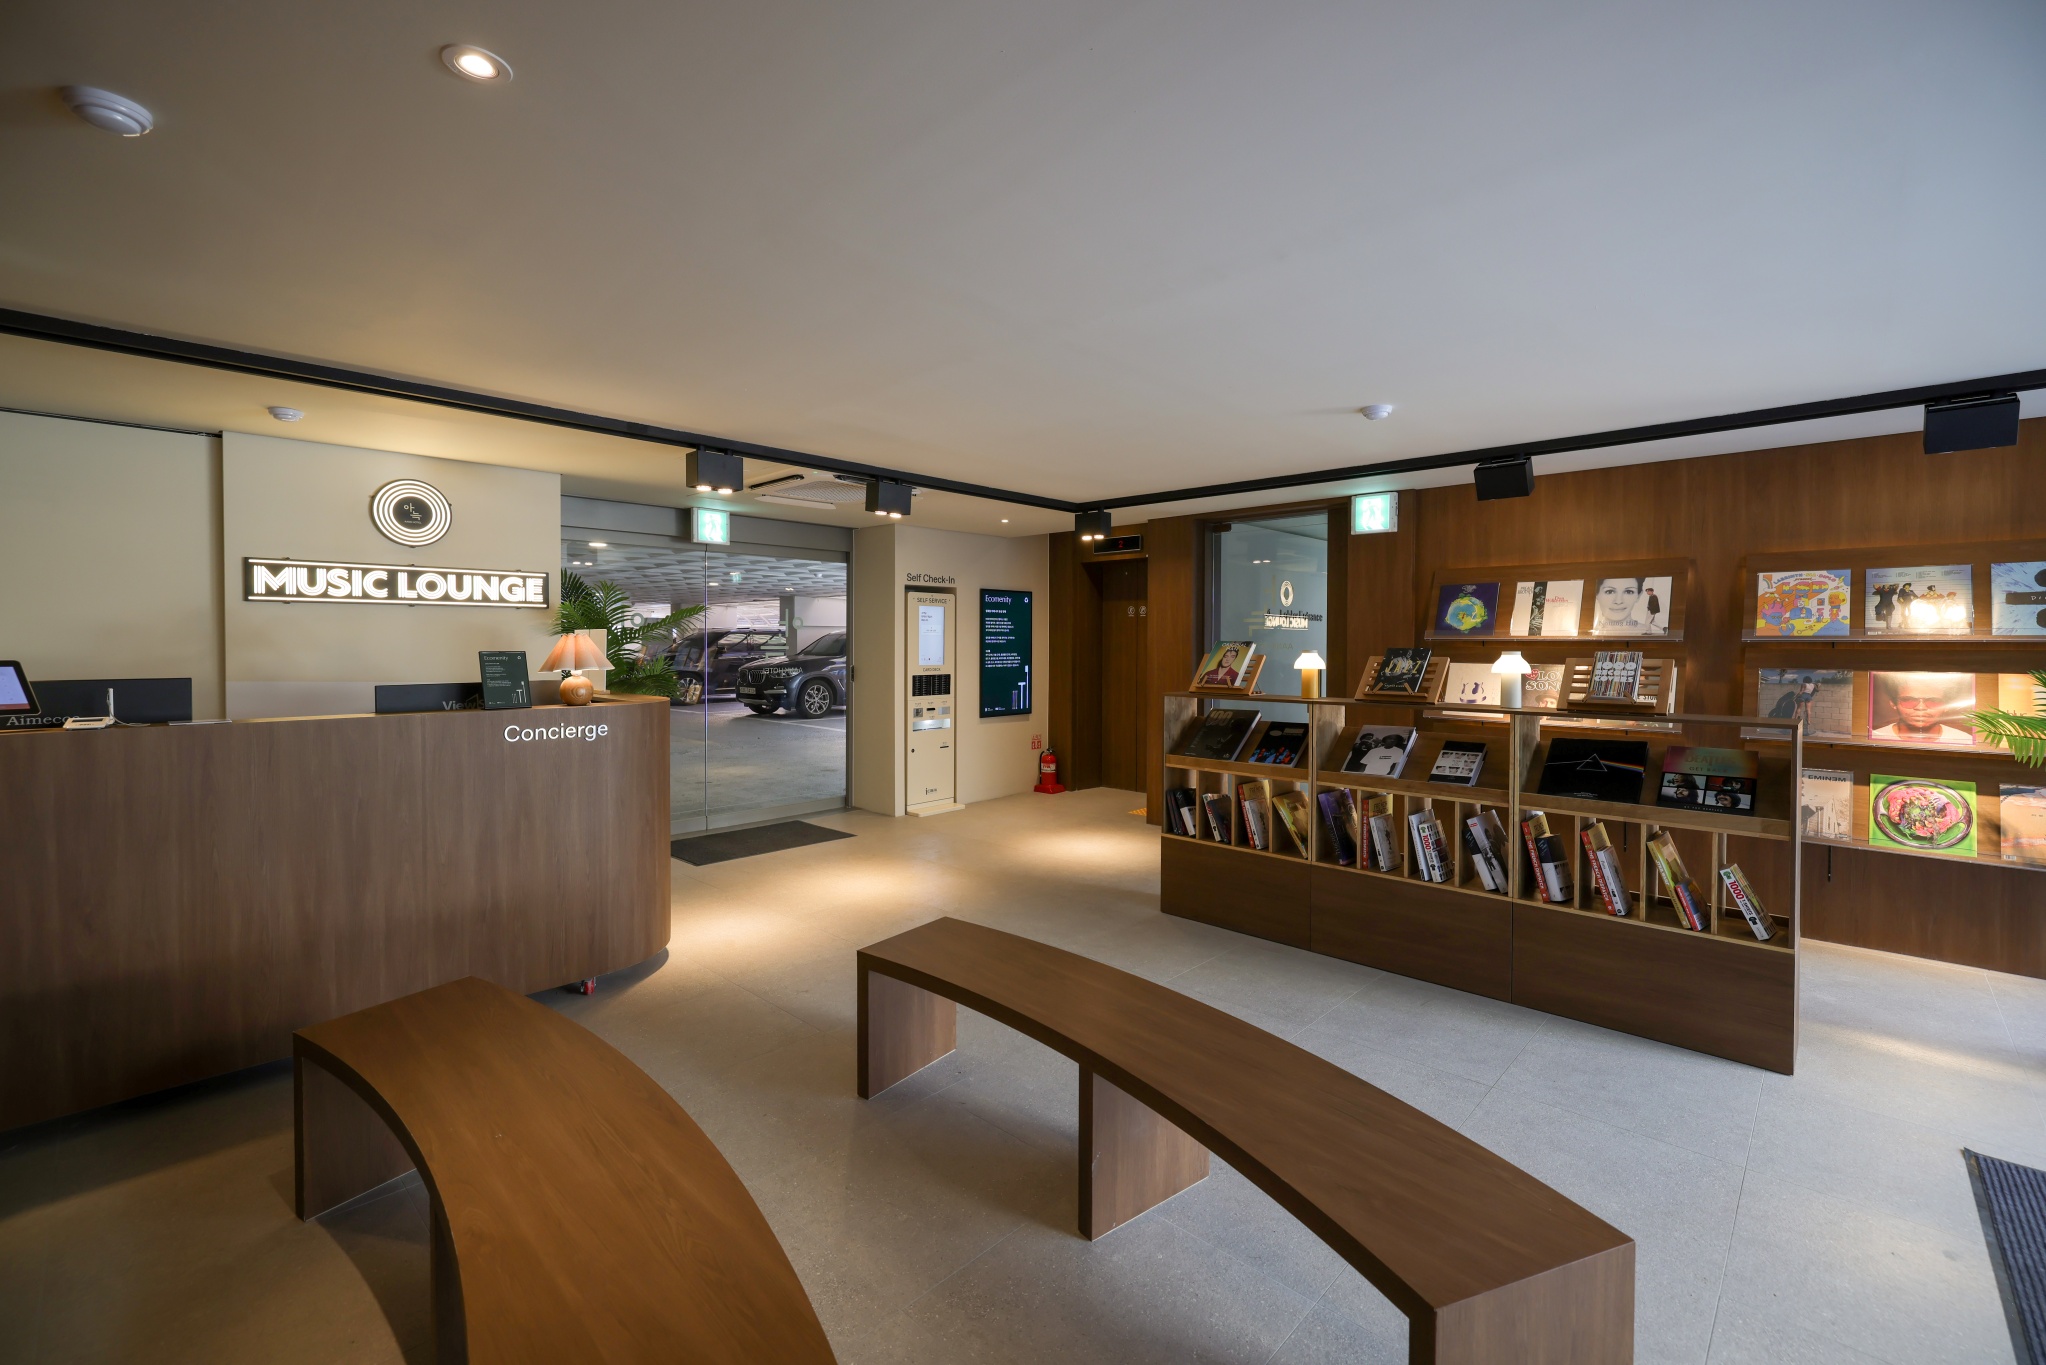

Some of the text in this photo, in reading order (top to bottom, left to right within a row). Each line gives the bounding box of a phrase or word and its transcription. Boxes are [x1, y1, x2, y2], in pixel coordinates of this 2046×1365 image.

[404, 503, 422, 520] 아늑
[253, 565, 543, 603] MUSIC LOUNGE
[906, 573, 955, 584] Self Check-In
[1781, 580, 1829, 594] LSD
[985, 595, 1012, 605] Ecomenity
[1597, 661, 1636, 670] 1000
[1526, 681, 1561, 691] SON
[504, 723, 608, 742] Concierge
[1422, 834, 1431, 850] 1000
[1590, 859, 1601, 878] FRENCH
[1597, 878, 1609, 901] DISPATCH
[1728, 880, 1745, 900] 1000
